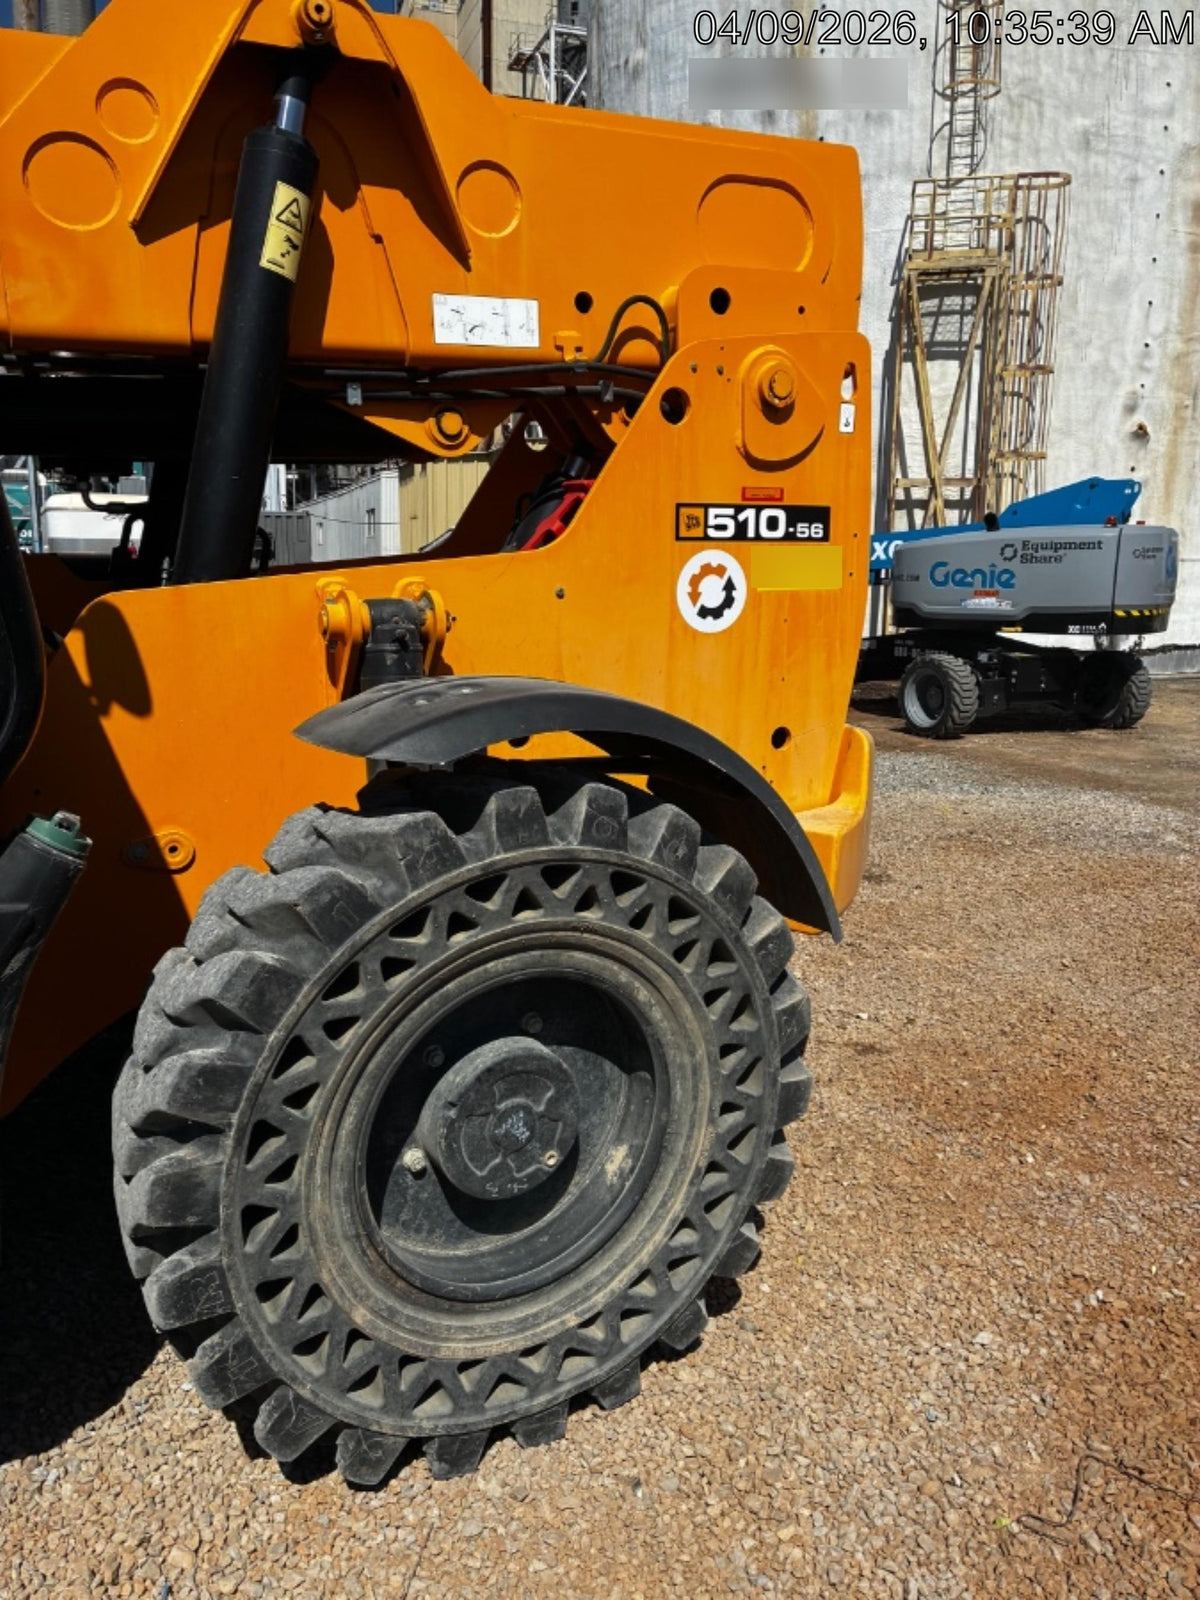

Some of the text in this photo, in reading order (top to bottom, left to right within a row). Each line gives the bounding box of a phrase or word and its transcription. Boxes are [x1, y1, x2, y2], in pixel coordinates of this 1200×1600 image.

[1021, 540, 1103, 553] Equipment
[1020, 553, 1063, 564] Share
[929, 561, 1016, 589] Genie
